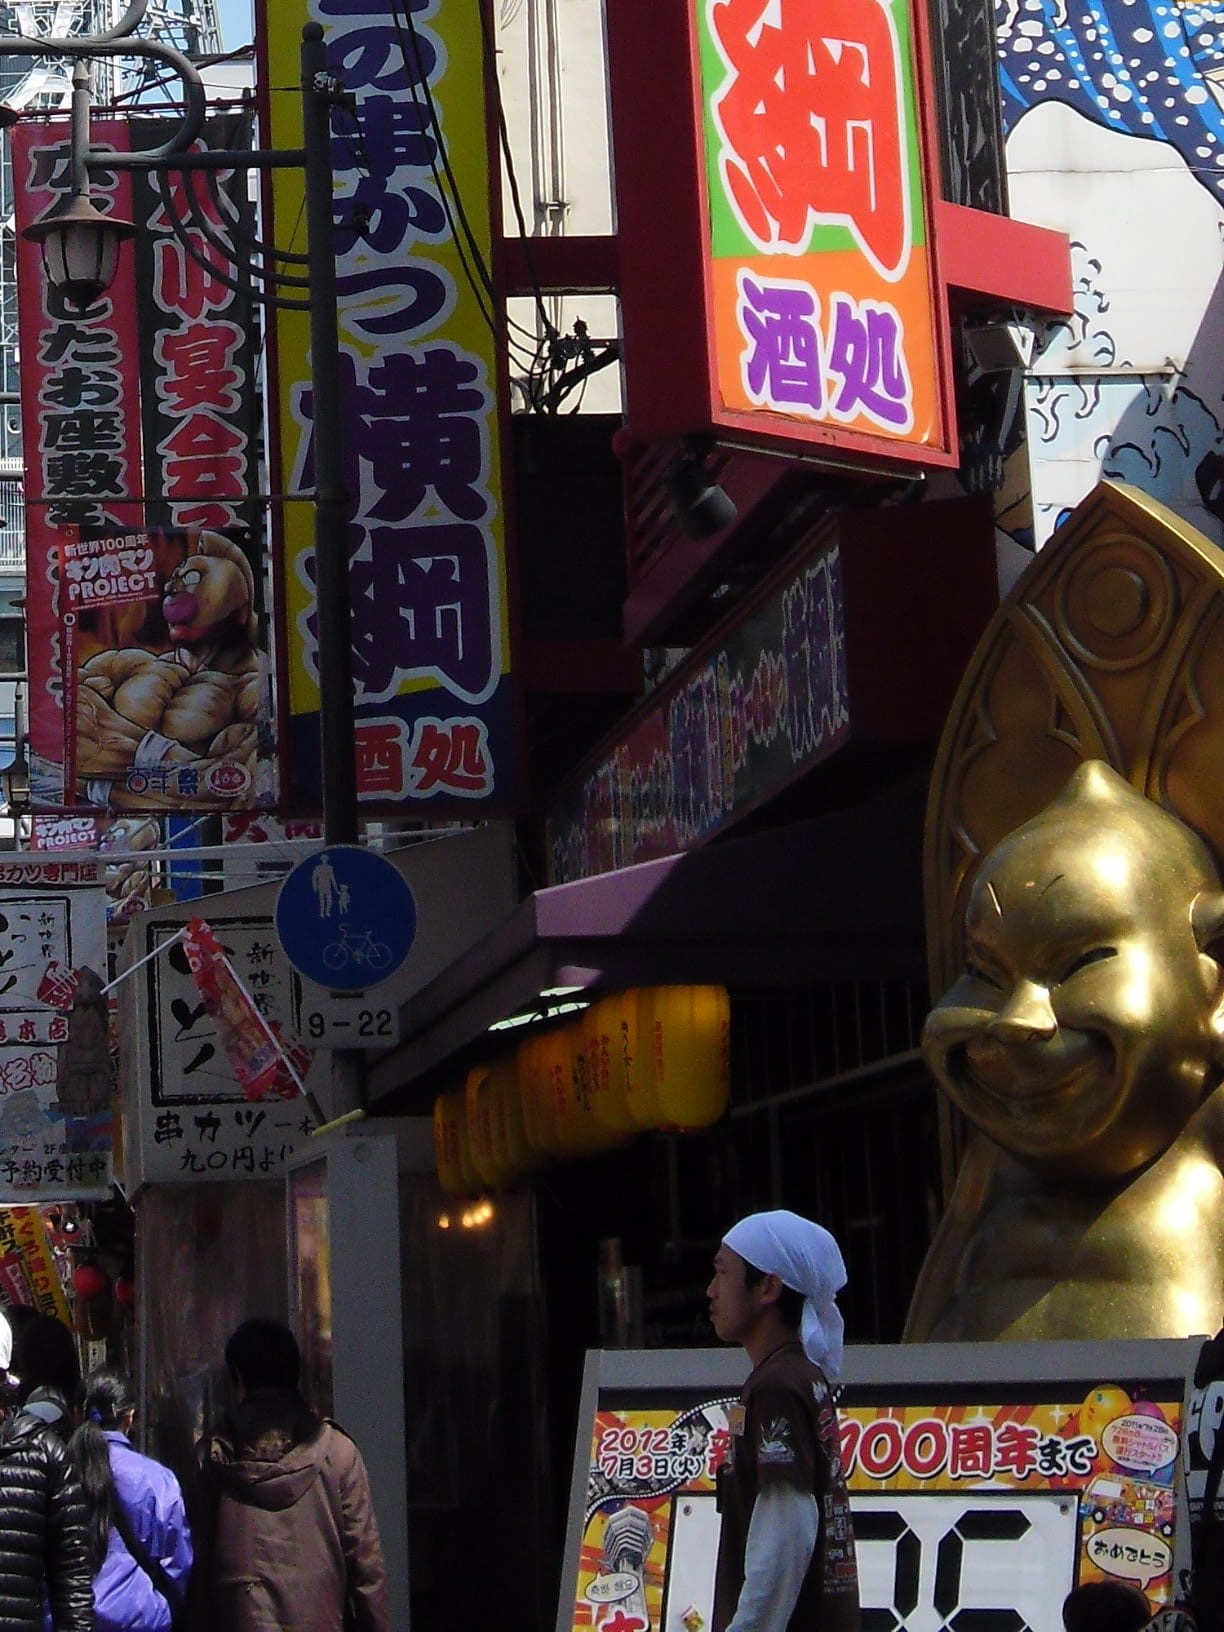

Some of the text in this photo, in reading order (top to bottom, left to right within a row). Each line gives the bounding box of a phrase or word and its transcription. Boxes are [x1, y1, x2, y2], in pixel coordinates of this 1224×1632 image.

[739, 277, 909, 428] 酒処
[299, 349, 494, 700] 横綱
[65, 548, 154, 582] キン肉マン
[68, 571, 157, 602] PROJECT
[37, 829, 96, 850] PROJECT
[308, 1009, 393, 1038] 9-22
[600, 1428, 688, 1455] 2012年
[600, 1454, 702, 1480] 7月3日(火)
[1094, 1539, 1167, 1569] おめでとう
